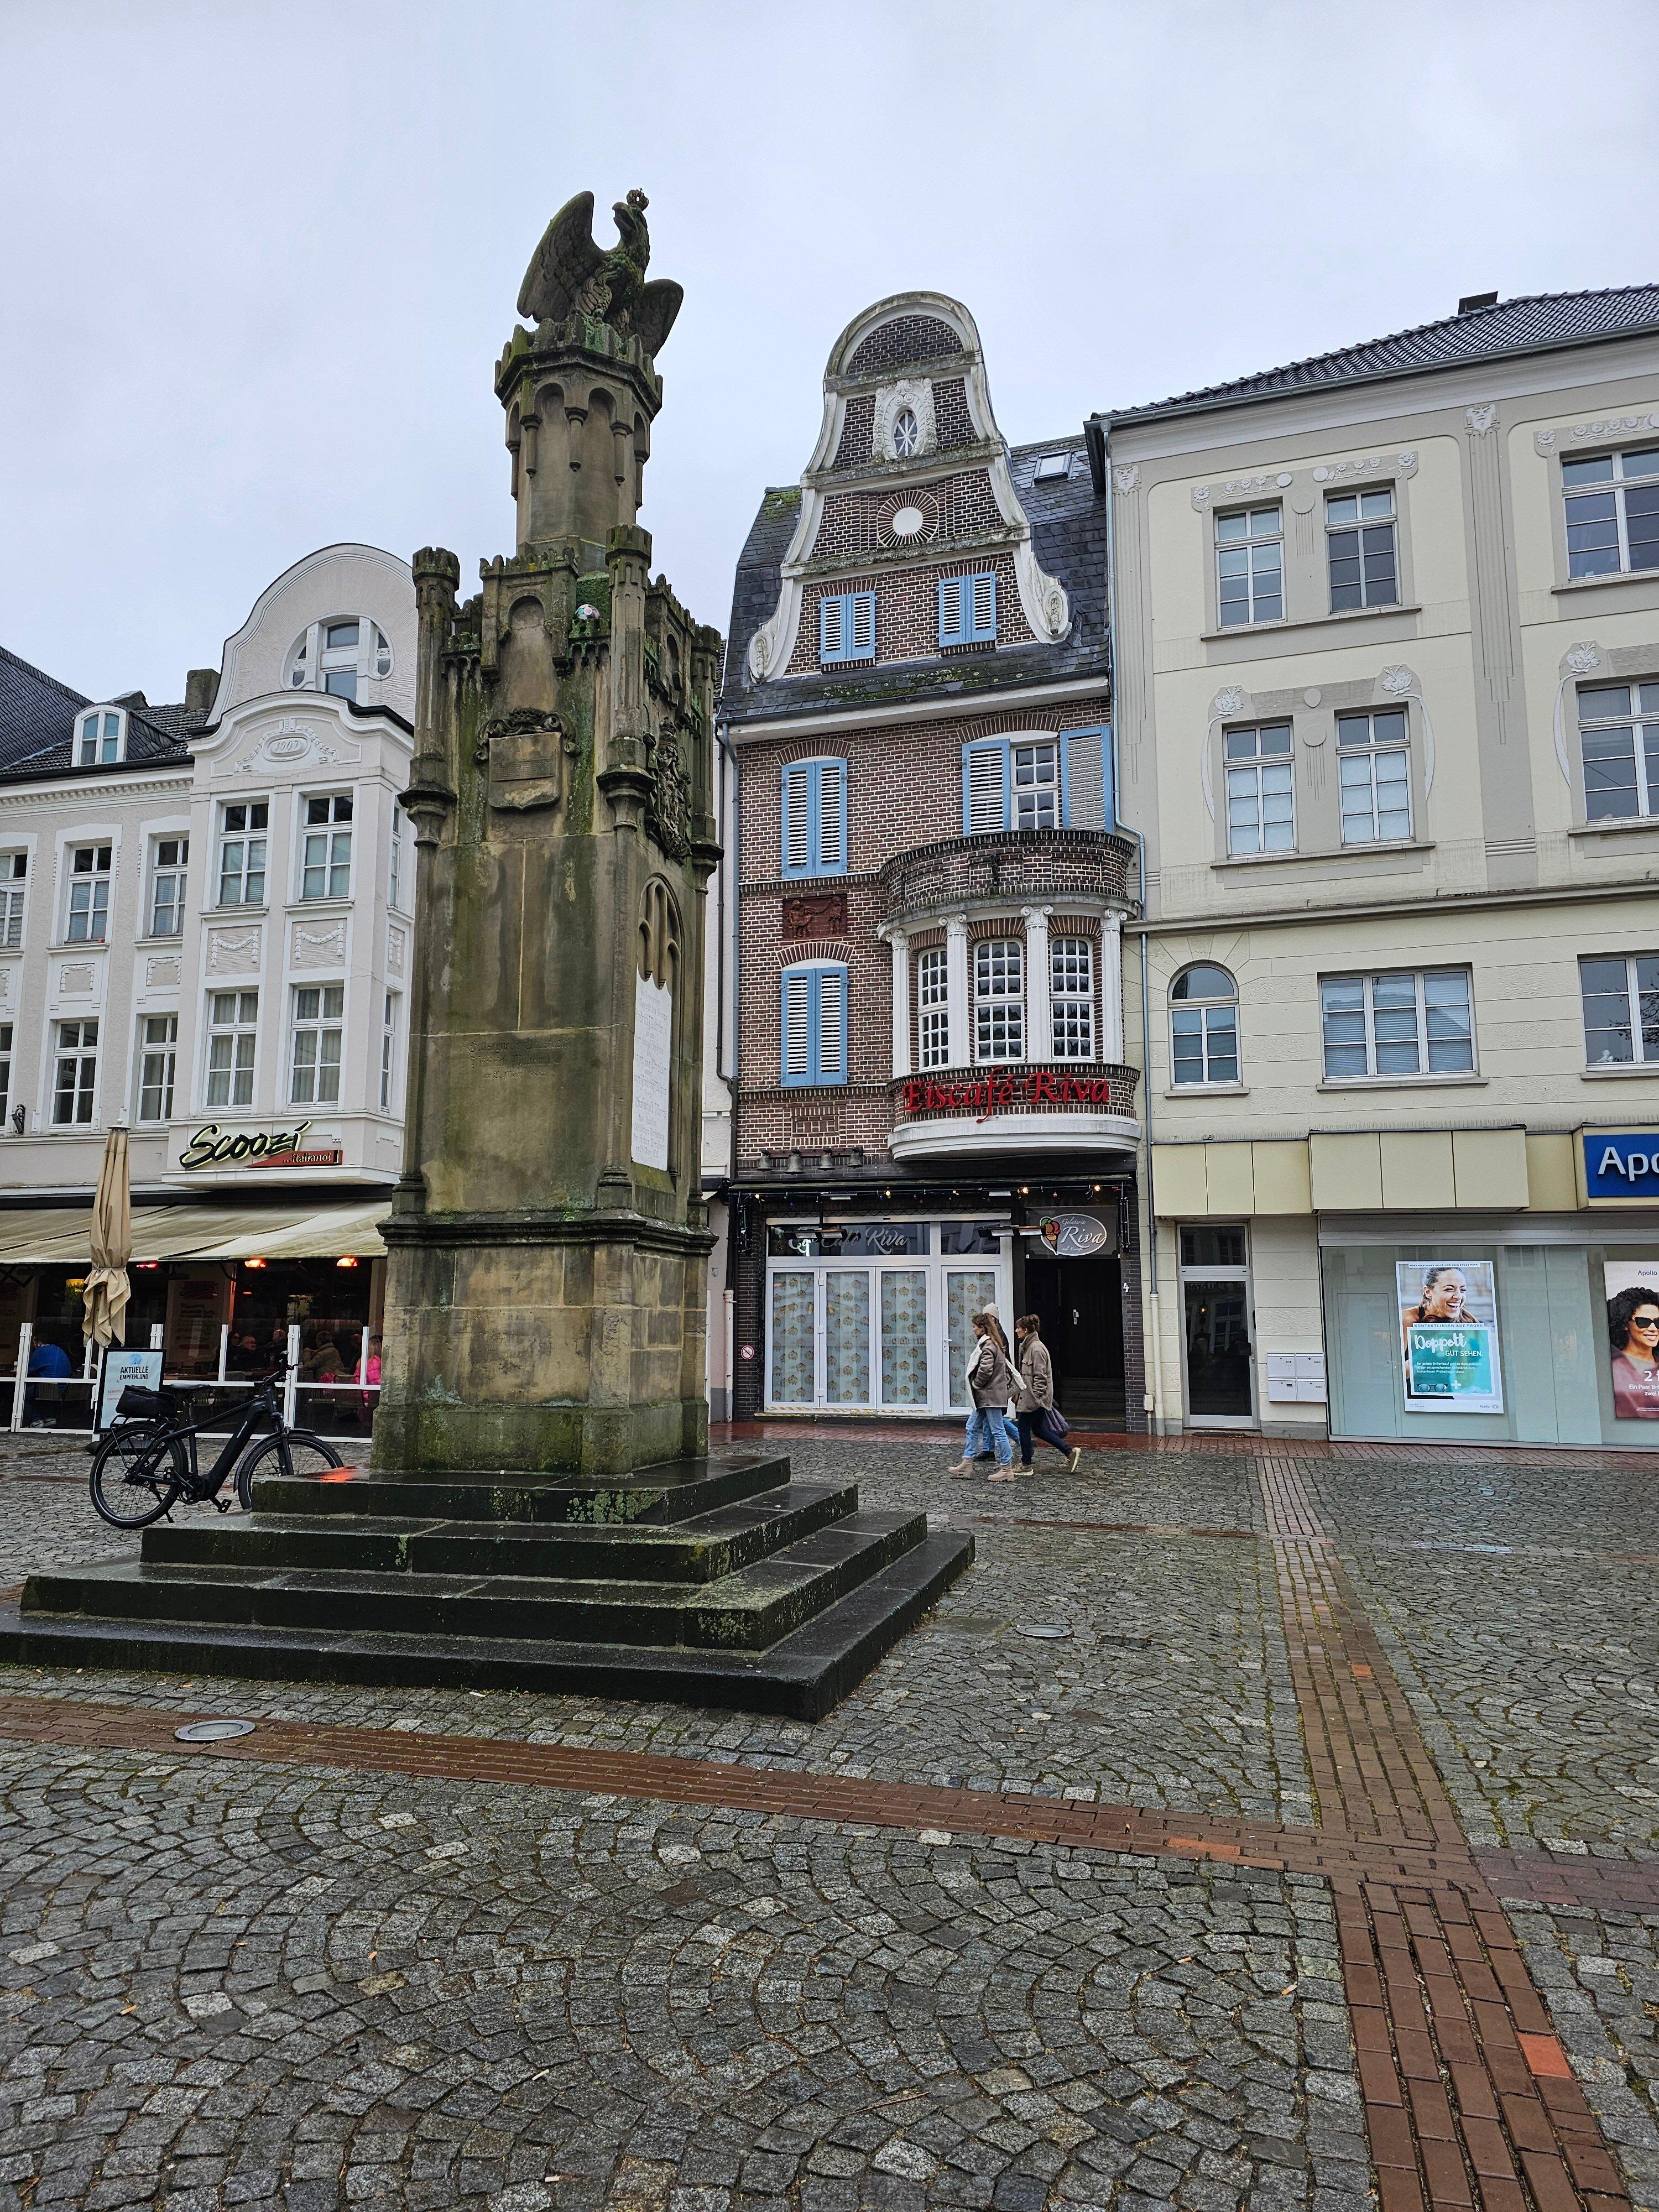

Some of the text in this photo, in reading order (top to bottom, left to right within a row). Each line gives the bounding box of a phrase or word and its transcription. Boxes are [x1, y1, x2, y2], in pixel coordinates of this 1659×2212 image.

[275, 740, 300, 752] 1907
[902, 1066, 1110, 1124] Eiscafé Riva
[1062, 1217, 1087, 1226] Gelateria
[865, 1226, 909, 1255] Riva
[1061, 1226, 1106, 1248] Riva
[1123, 1283, 1130, 1293] 4
[1414, 1332, 1467, 1353] Doppelt
[1644, 1370, 1653, 1381] 2
